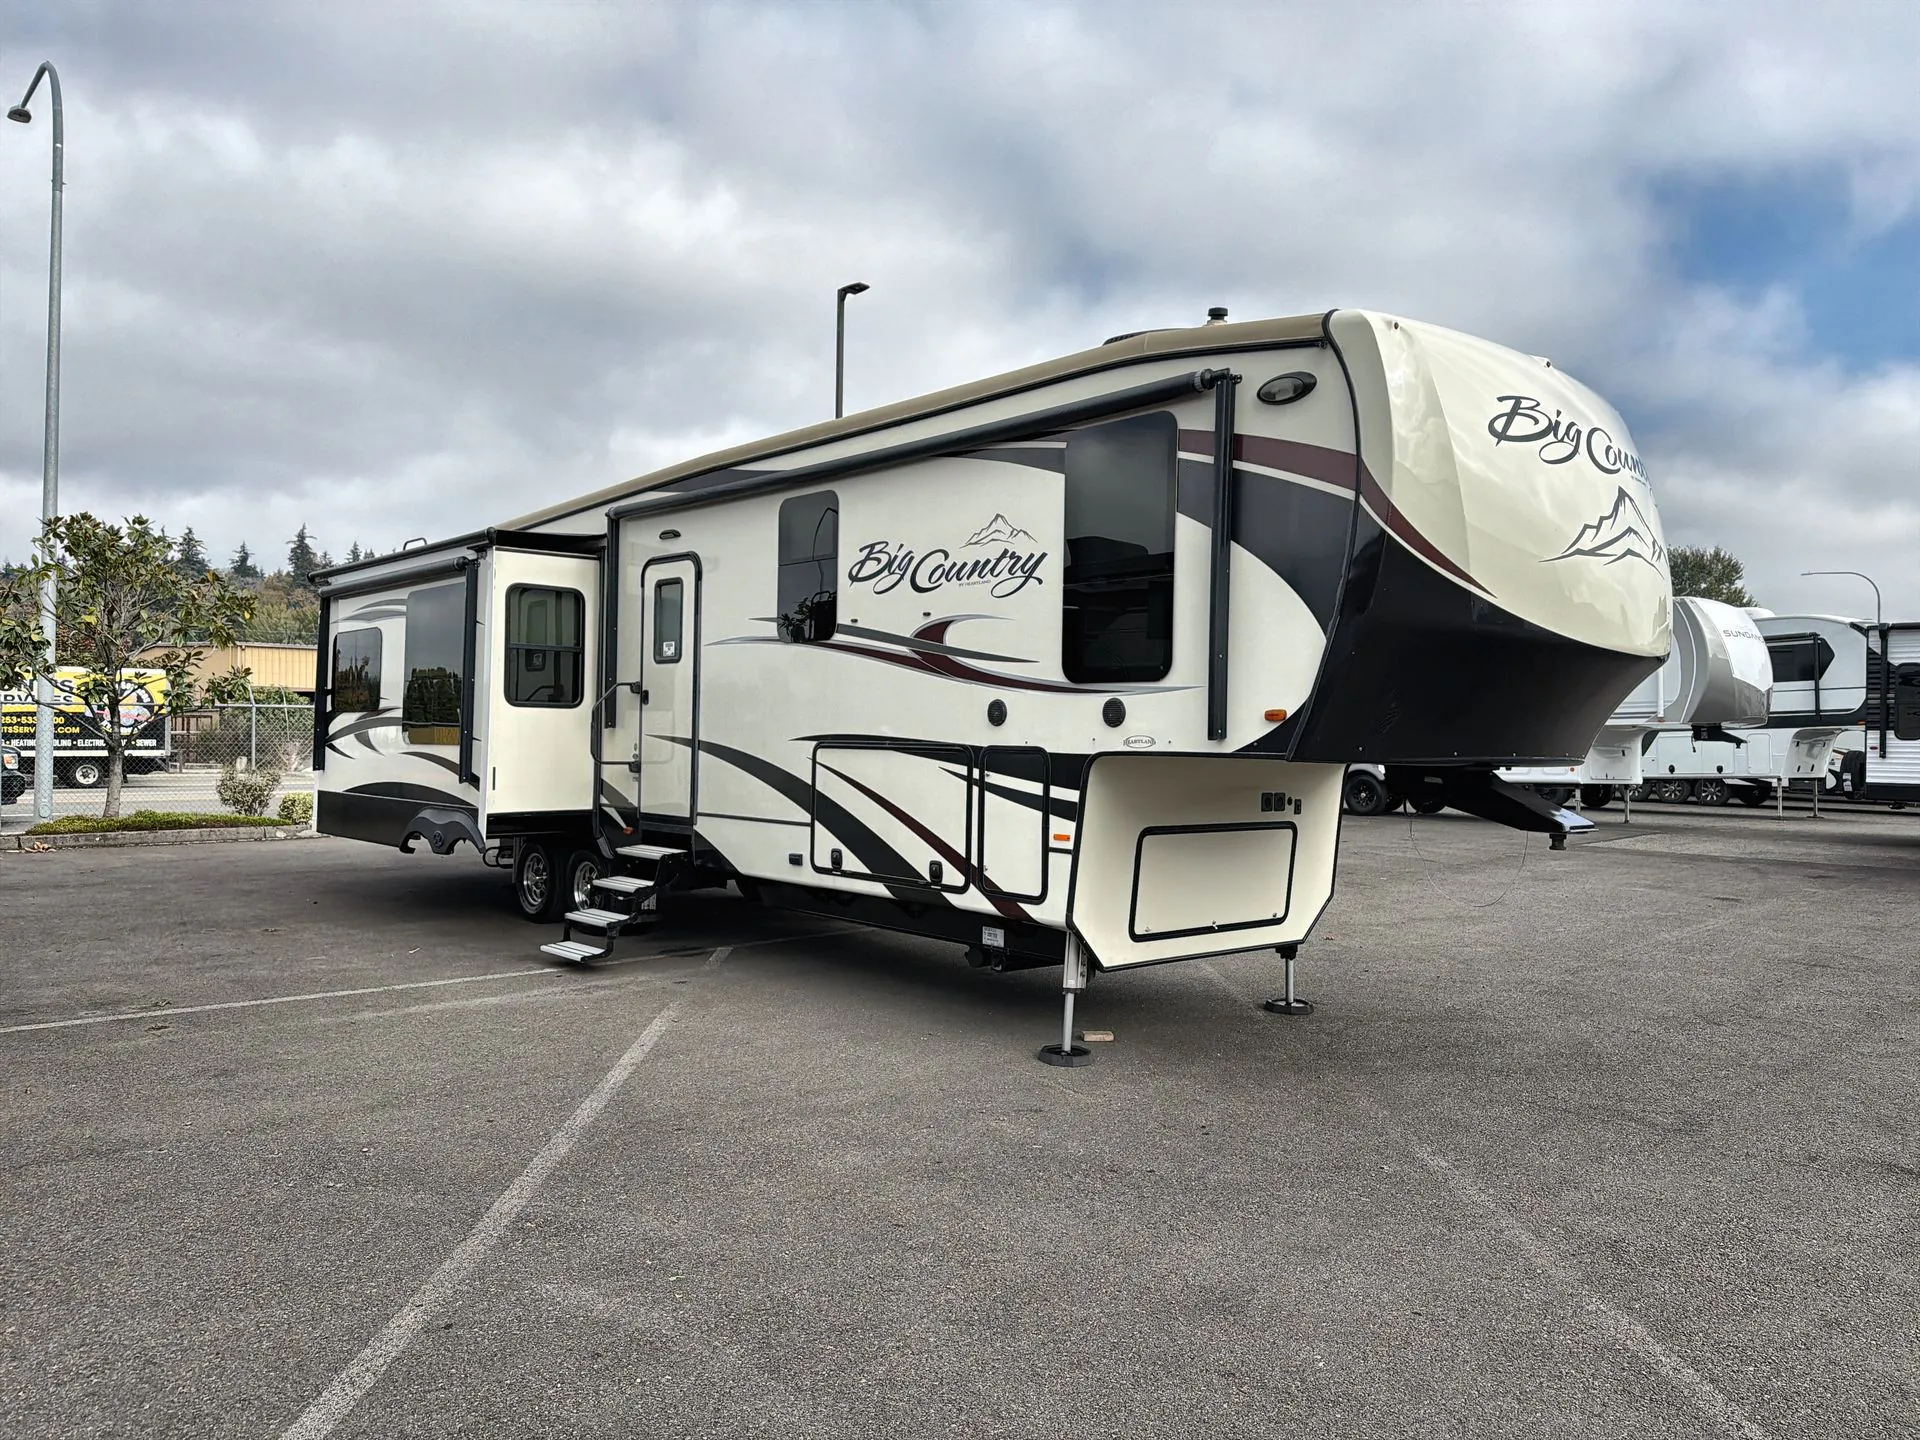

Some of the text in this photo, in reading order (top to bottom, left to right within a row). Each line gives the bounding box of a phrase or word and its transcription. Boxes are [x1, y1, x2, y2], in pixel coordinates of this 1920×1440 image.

[1487, 395, 1582, 465] Big
[848, 541, 1048, 599] Big Country
[136, 739, 157, 747] SEWER
